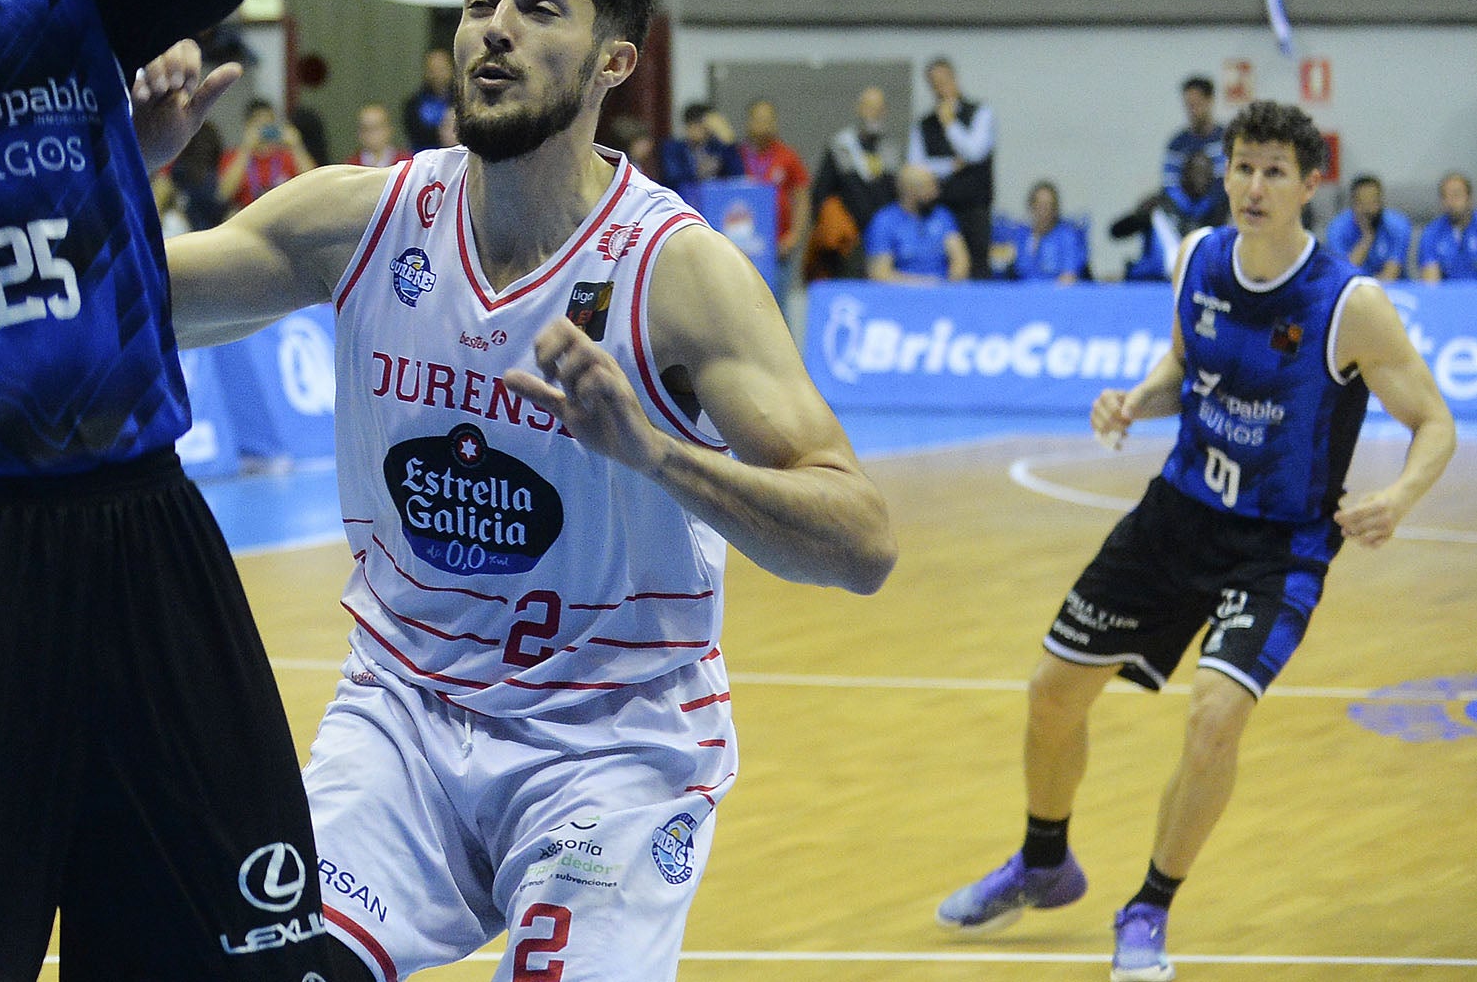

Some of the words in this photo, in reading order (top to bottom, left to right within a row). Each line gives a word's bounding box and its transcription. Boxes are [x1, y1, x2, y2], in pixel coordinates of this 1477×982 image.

[572, 288, 595, 305] Liga
[459, 330, 490, 352] besten
[372, 350, 577, 439] OURENS
[401, 457, 533, 513] Estrella
[406, 494, 528, 546] Galicia
[502, 589, 562, 669] 2
[317, 856, 388, 923] RSAN
[512, 902, 573, 982] 2
